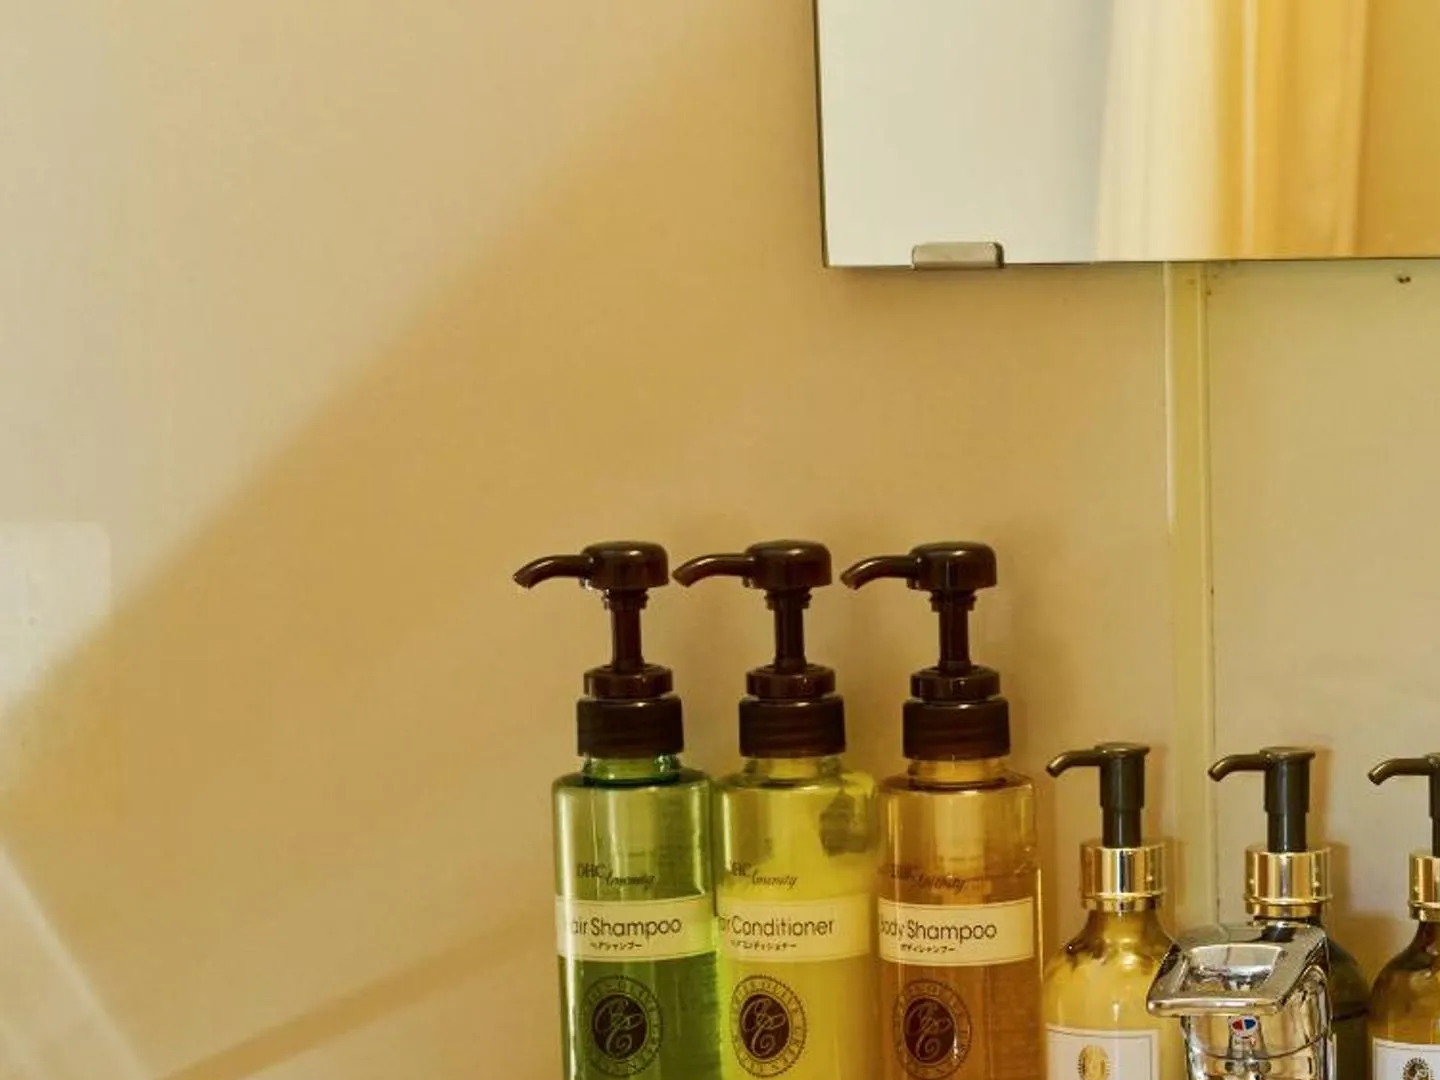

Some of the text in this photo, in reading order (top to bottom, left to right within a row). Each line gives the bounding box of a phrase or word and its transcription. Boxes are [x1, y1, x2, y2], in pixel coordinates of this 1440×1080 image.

[590, 916, 683, 940] Shampoo
[731, 915, 834, 937] Conditioner
[907, 919, 998, 945] Shampoo
